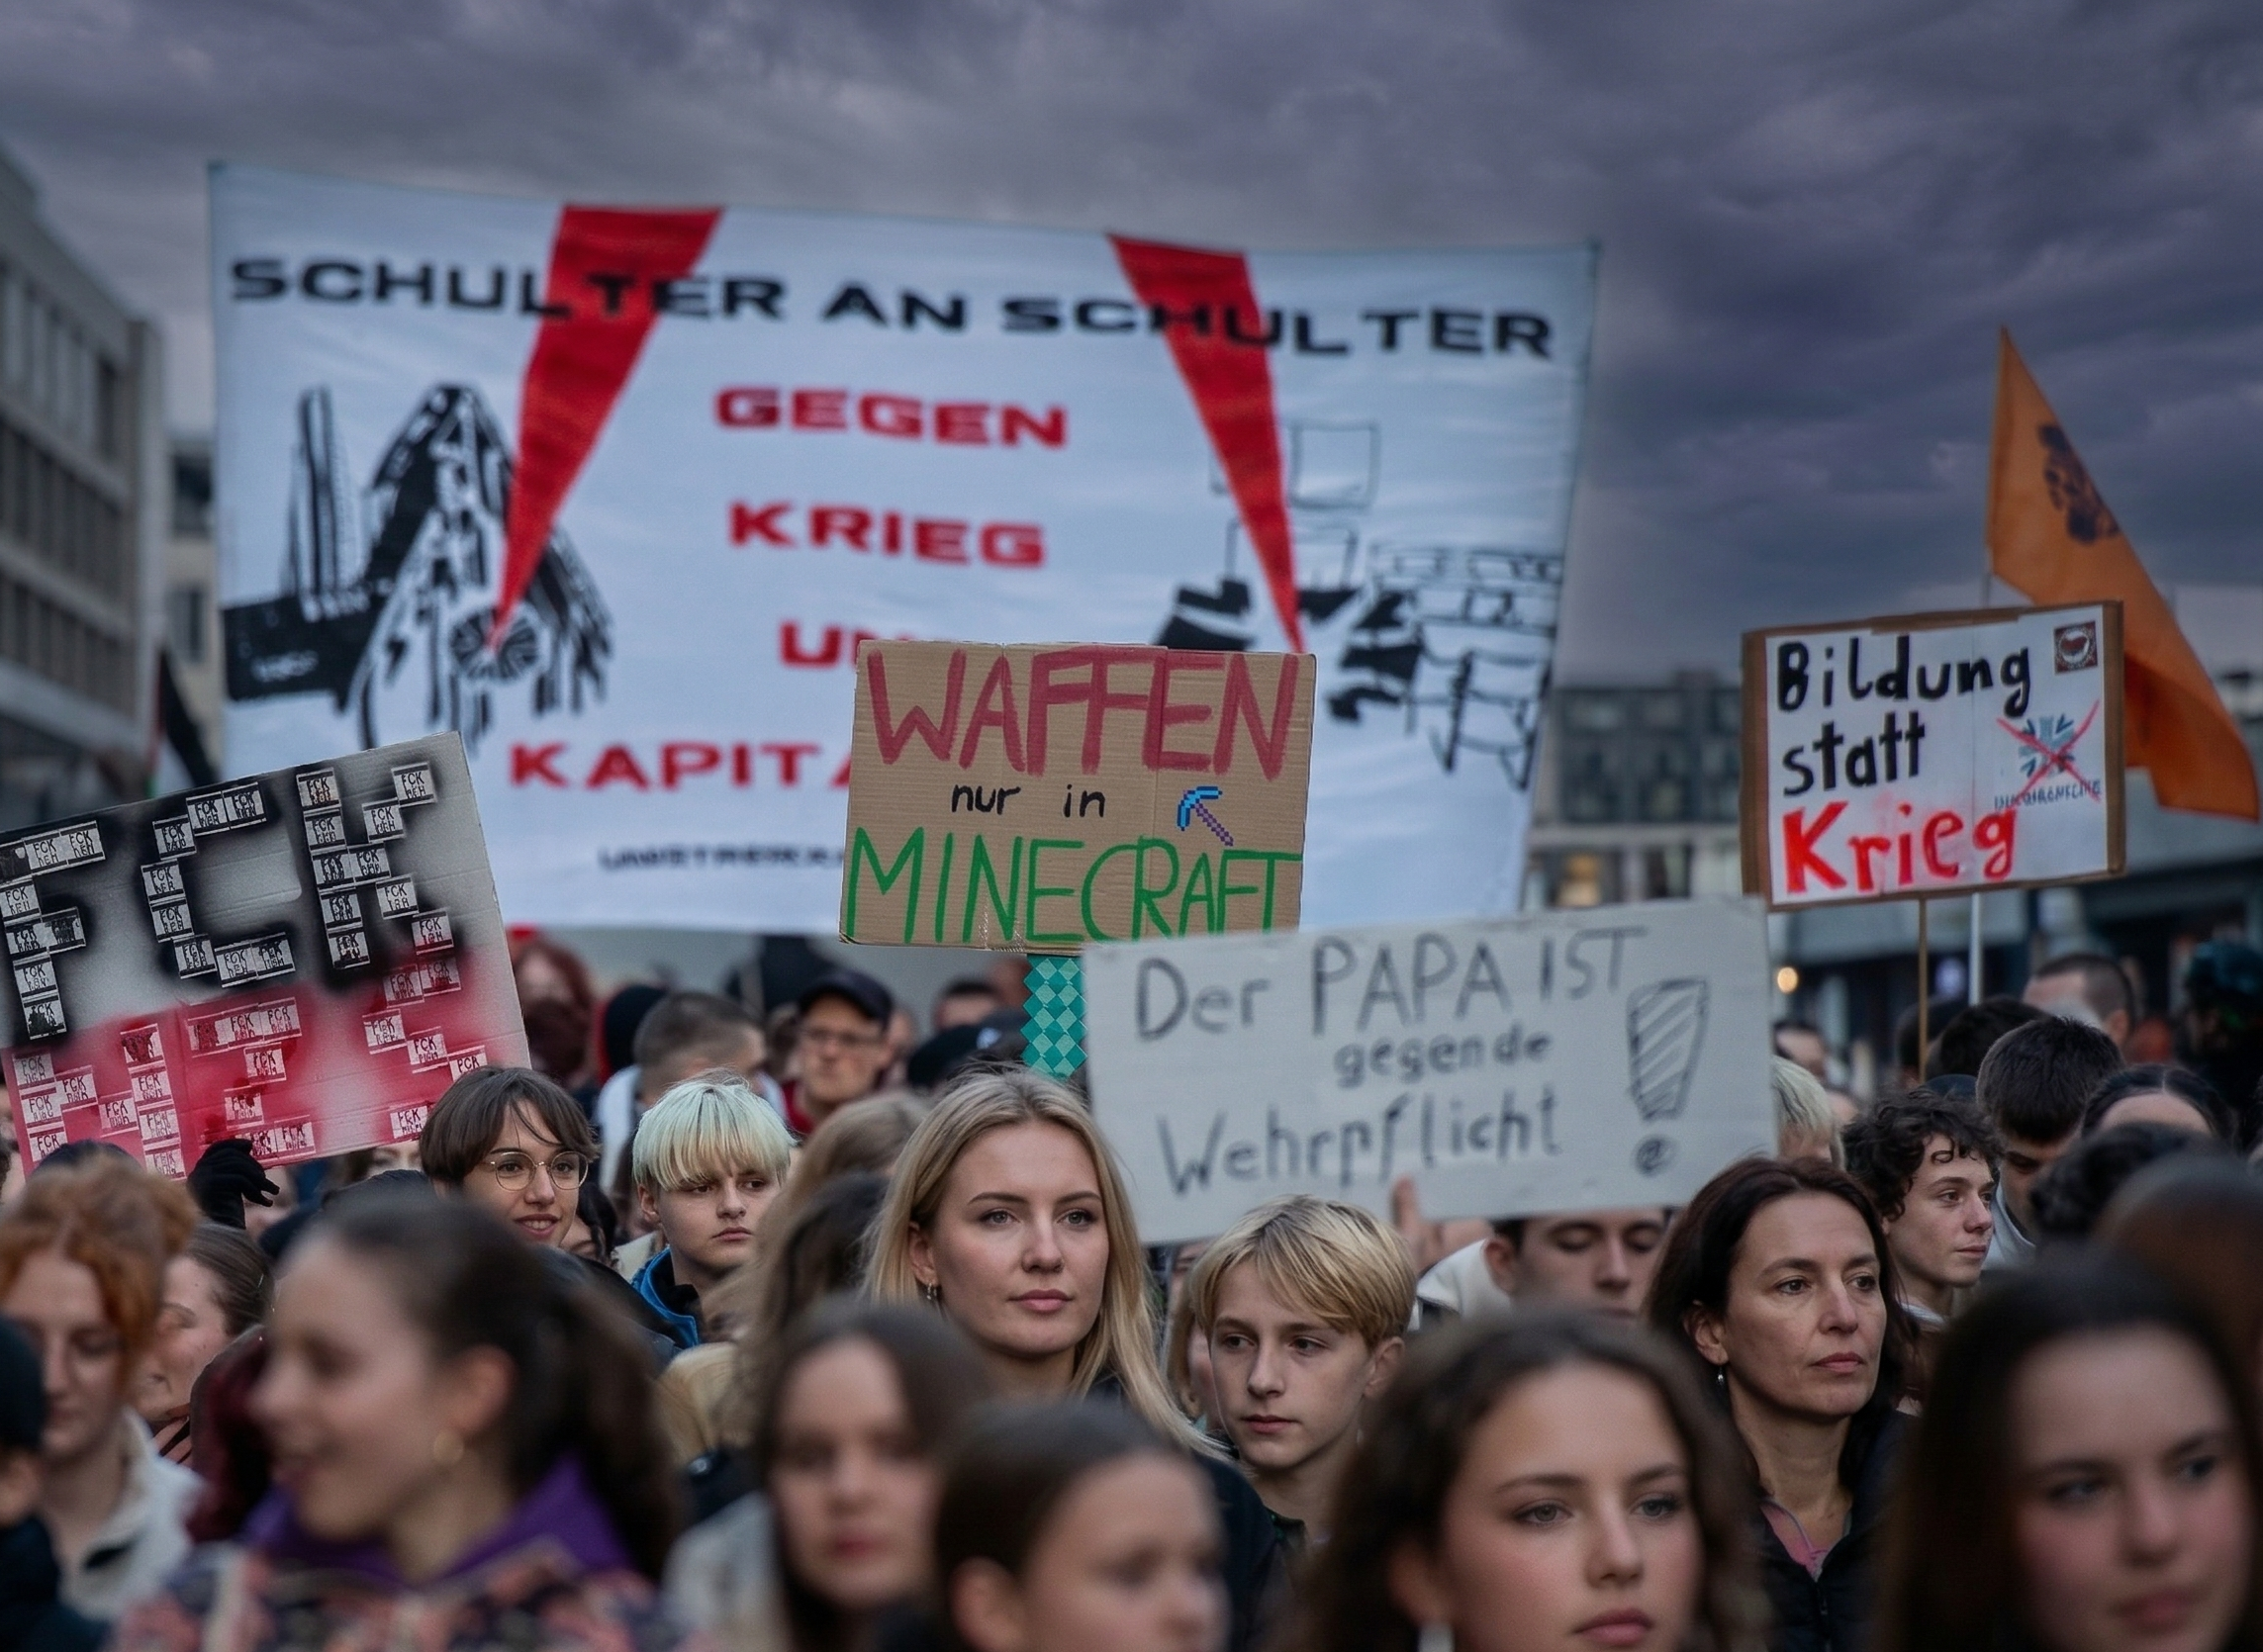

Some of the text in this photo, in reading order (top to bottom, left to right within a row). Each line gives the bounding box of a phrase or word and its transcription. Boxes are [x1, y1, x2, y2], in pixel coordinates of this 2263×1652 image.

[231, 258, 1554, 357] SCHULTER AN SCHULTER
[716, 387, 1067, 448] GEGEN
[728, 502, 1047, 568] KRIEG
[867, 646, 1299, 781] WAFFEN
[1777, 634, 2029, 718] Bildung
[510, 740, 850, 789] KAPIT
[1783, 711, 1926, 797] statt
[952, 783, 1105, 817] nur in
[846, 826, 1303, 944] MINECRAFT
[1783, 801, 2017, 894] Krieg
[1136, 925, 1649, 1042] Der PAPA IST
[1158, 1084, 1563, 1195] Wehrpflicht
